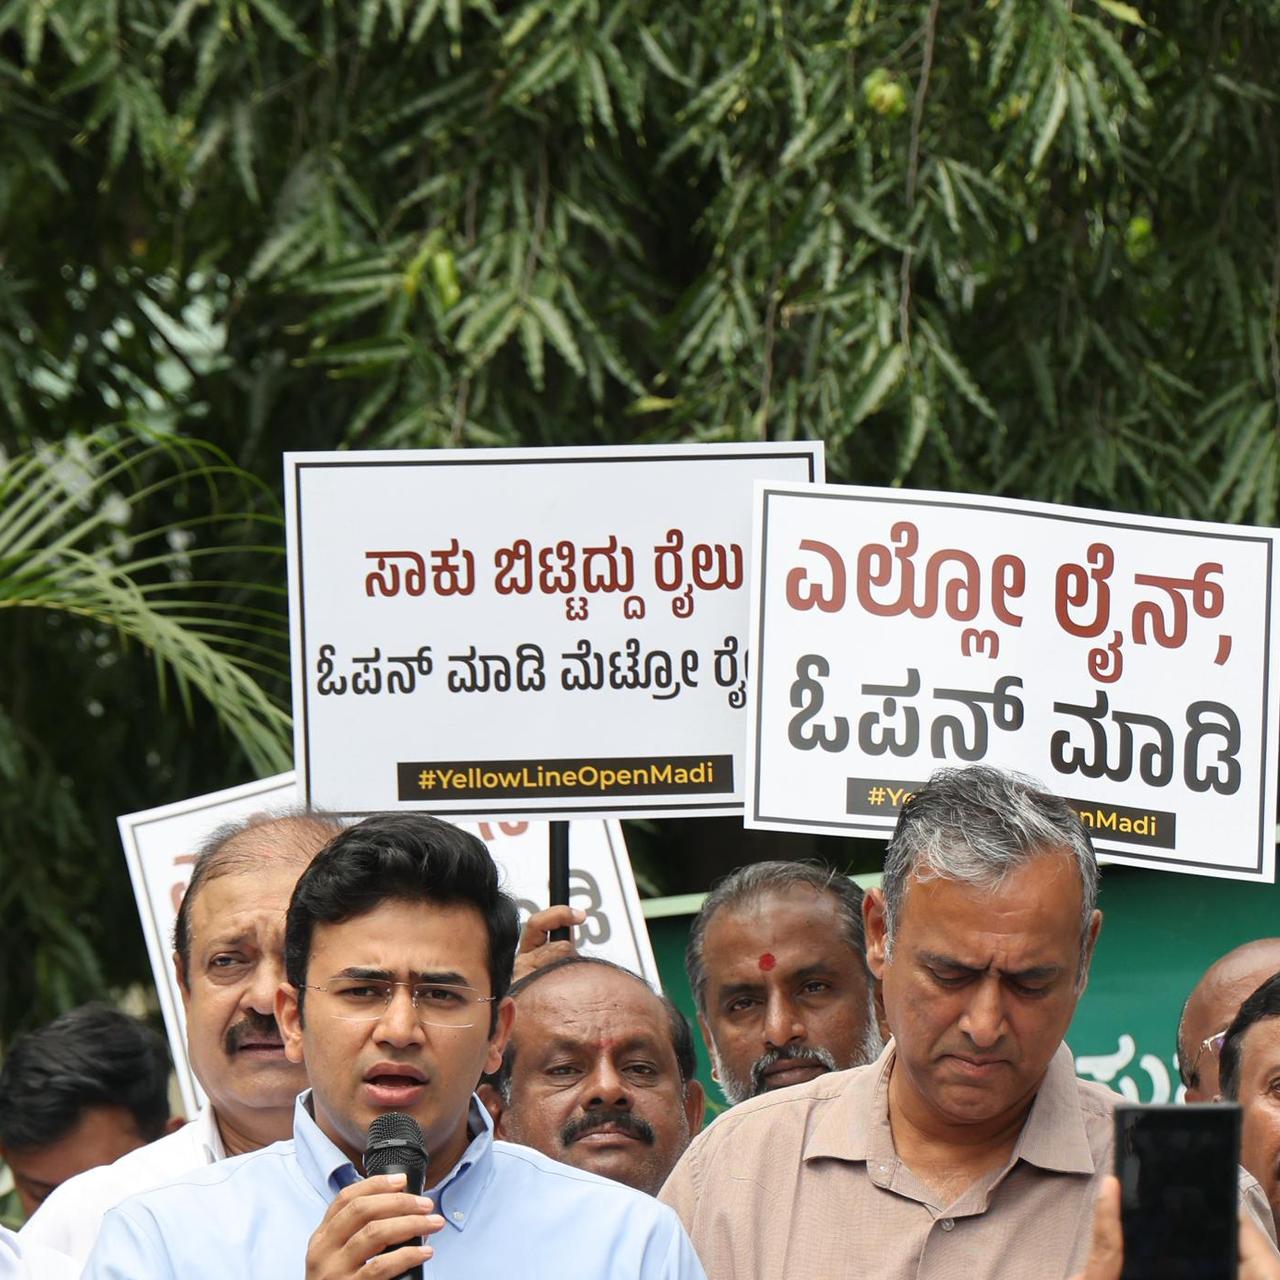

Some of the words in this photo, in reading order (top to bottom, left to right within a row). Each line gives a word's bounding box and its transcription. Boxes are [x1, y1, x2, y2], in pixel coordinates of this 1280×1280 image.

[365, 538, 476, 598] ಸಾಕು
[493, 535, 646, 621] ಬಿಟ್ಟಿದ್ದು
[653, 528, 745, 618] ರೈಲು
[785, 520, 1026, 660] ಎಲ್ಲೋ
[1054, 541, 1233, 684] ಲೈನ್,
[316, 643, 433, 696] ಓಪನ್
[447, 642, 546, 694] ಮಾಡಿ
[561, 637, 699, 700] ಮೆಟ್ರೋ
[787, 653, 1025, 762] ಓಪನ್
[1049, 689, 1242, 796] ಮಾಡಿ
[417, 761, 714, 791] #YellowLineOpenMadi
